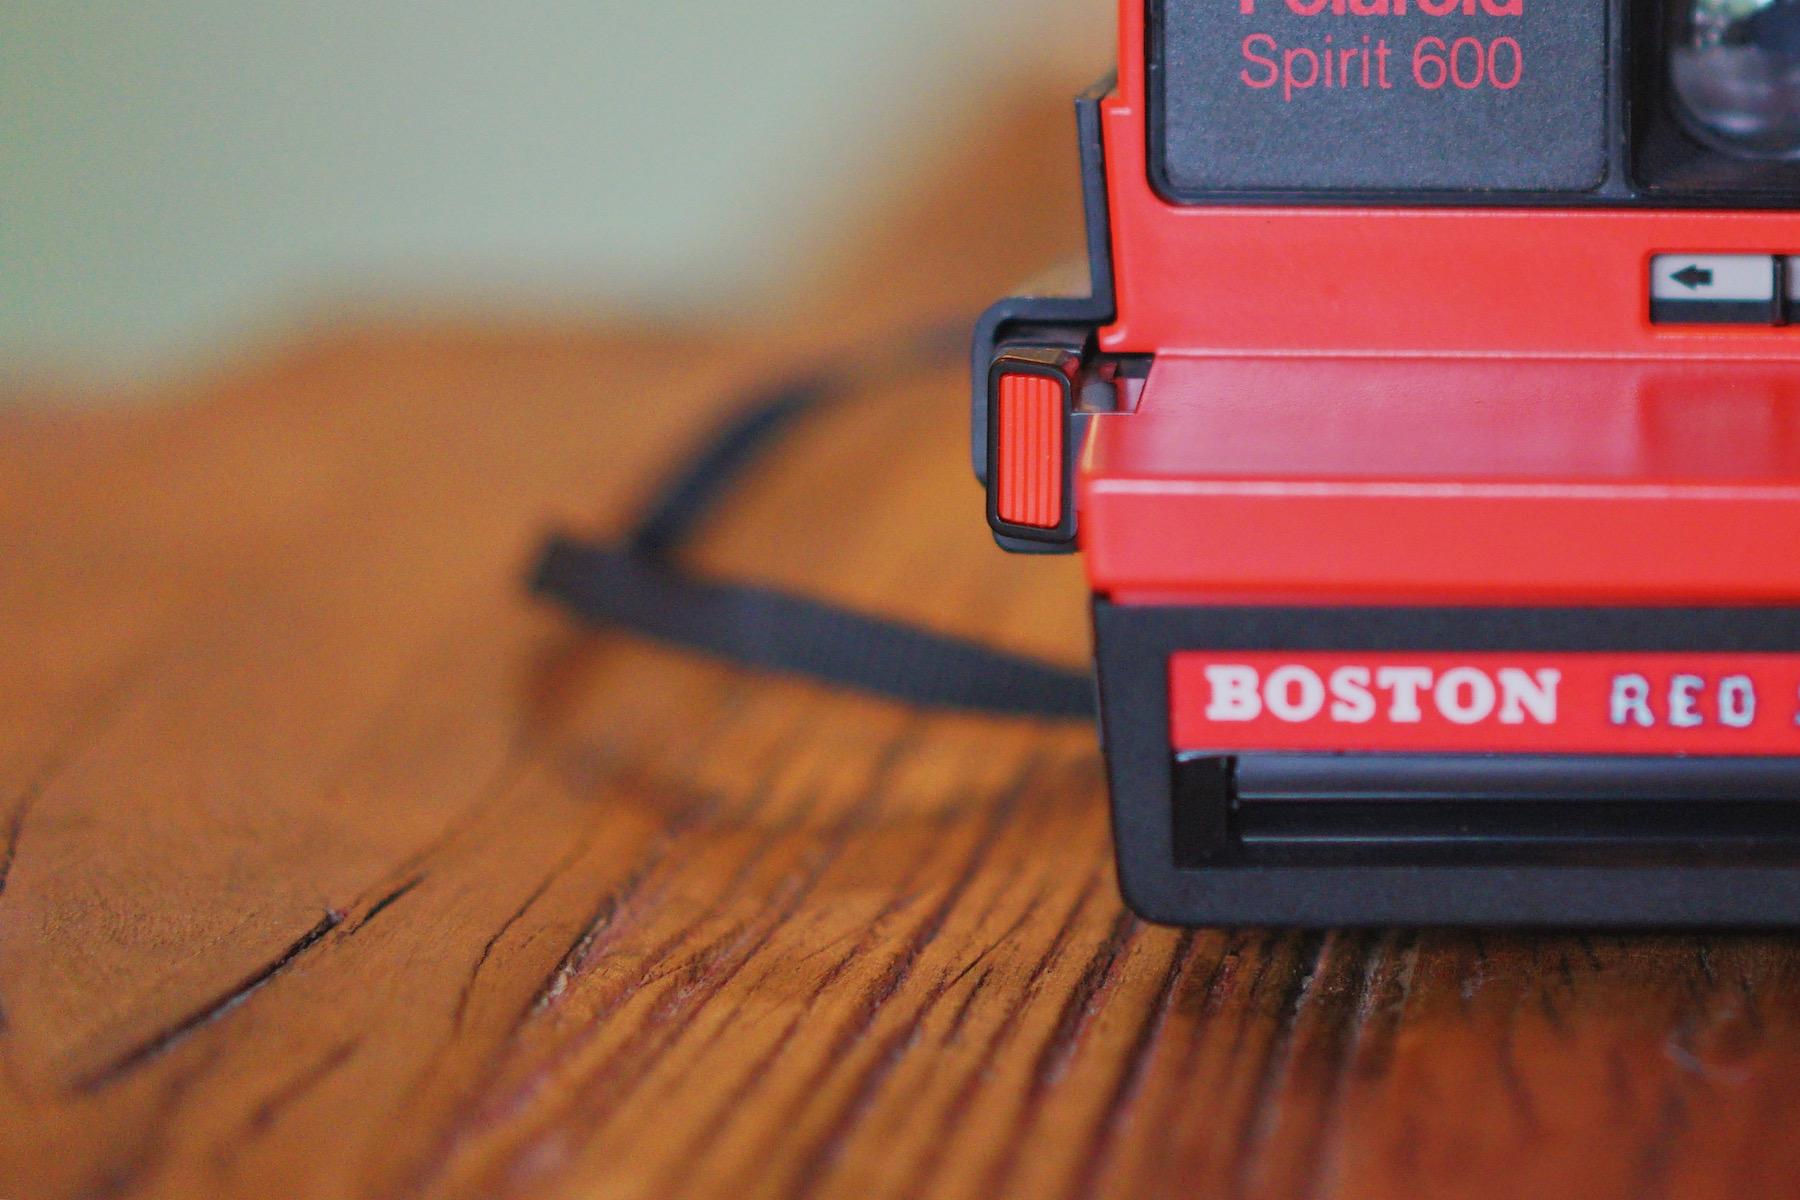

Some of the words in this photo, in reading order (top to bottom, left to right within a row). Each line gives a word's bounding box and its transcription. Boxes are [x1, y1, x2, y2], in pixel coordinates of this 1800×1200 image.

[1240, 33, 1393, 101] Spirit
[1411, 35, 1524, 90] 600
[1203, 663, 1562, 725] BOSTON
[1610, 673, 1757, 728] RED
